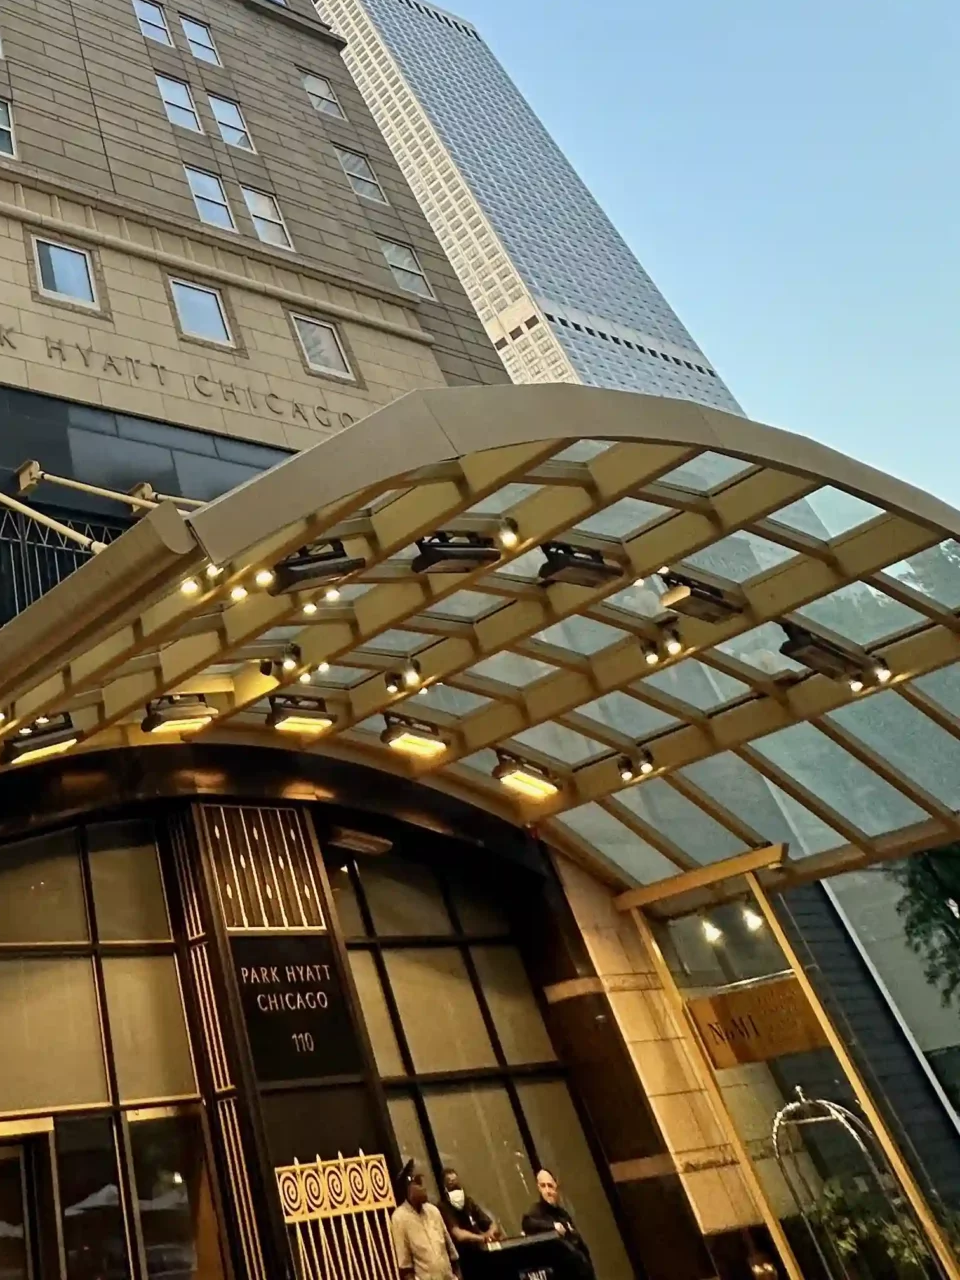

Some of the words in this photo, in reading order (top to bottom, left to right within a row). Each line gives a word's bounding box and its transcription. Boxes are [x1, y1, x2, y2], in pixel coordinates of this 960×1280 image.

[45, 335, 166, 386] HYATT
[240, 966, 280, 984] PARK
[285, 964, 331, 983] HYATT
[256, 991, 328, 1012] CHICAGO
[291, 1032, 314, 1052] 110
